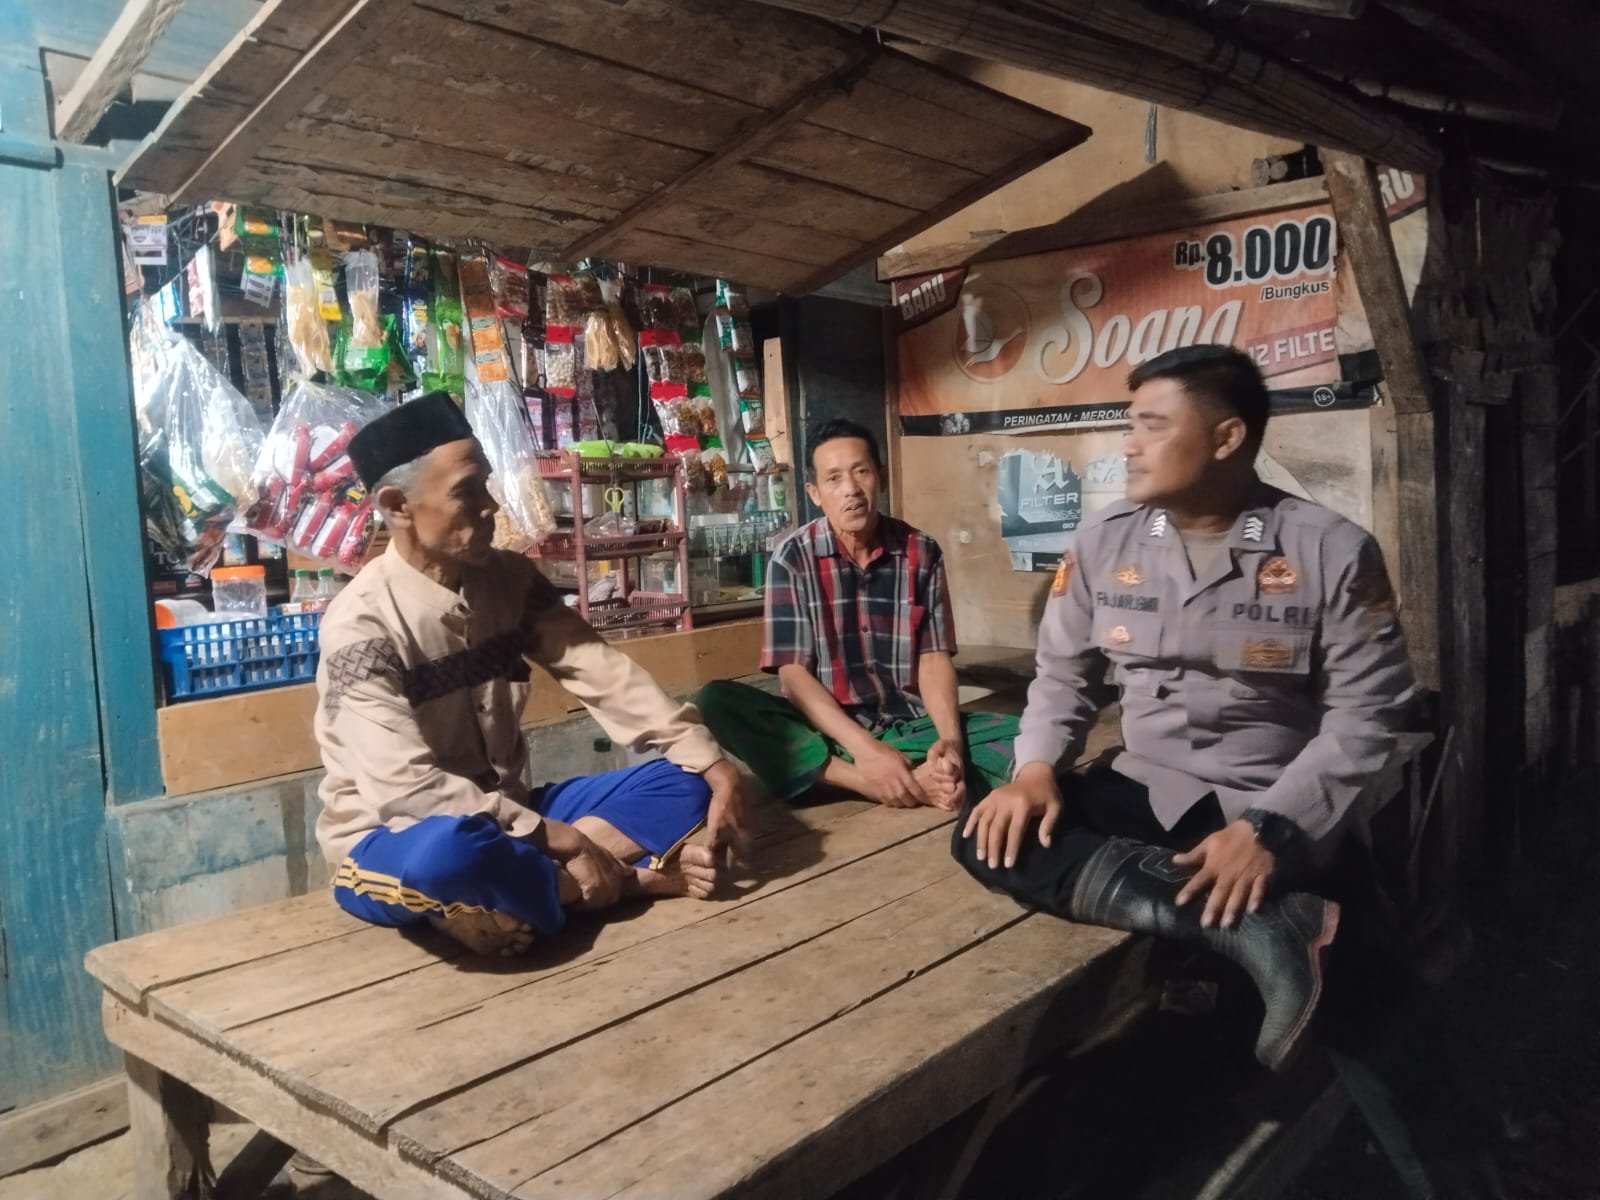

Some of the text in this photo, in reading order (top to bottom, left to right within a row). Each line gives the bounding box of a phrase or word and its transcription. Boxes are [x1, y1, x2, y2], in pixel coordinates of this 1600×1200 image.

[899, 273, 946, 320] BARU
[1274, 325, 1338, 363] FILTE
[1021, 492, 1079, 508] FILTER
[1232, 603, 1310, 625] POLRI
